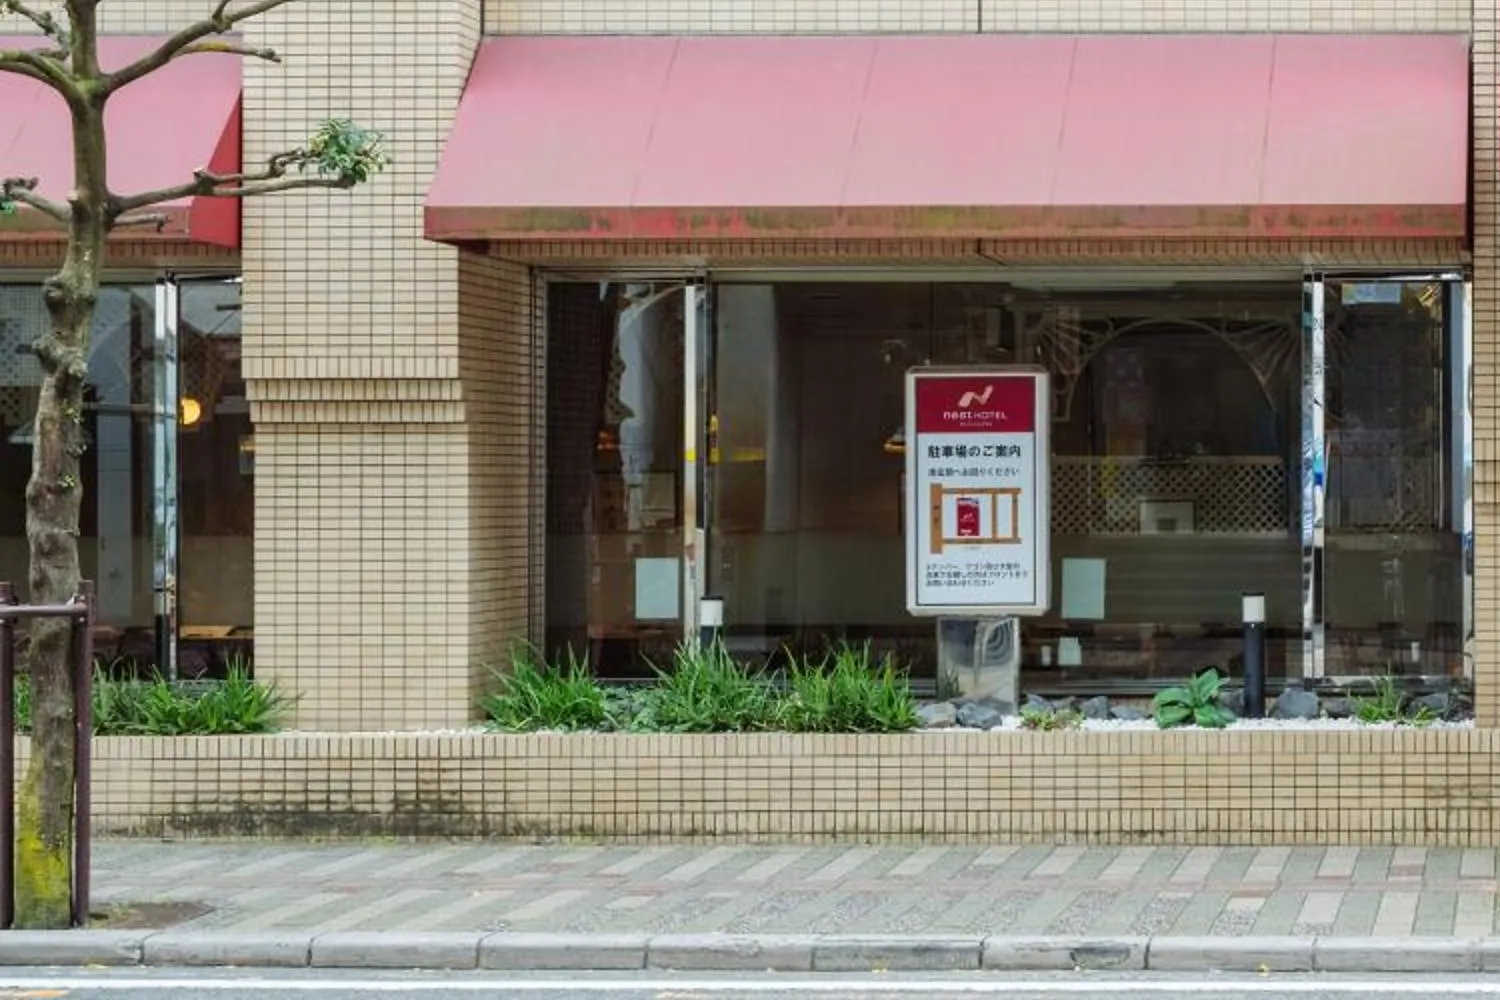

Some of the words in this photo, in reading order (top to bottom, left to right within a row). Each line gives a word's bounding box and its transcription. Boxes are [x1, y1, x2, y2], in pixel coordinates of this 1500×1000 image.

[927, 444, 1021, 459] 駐車場のご案内
